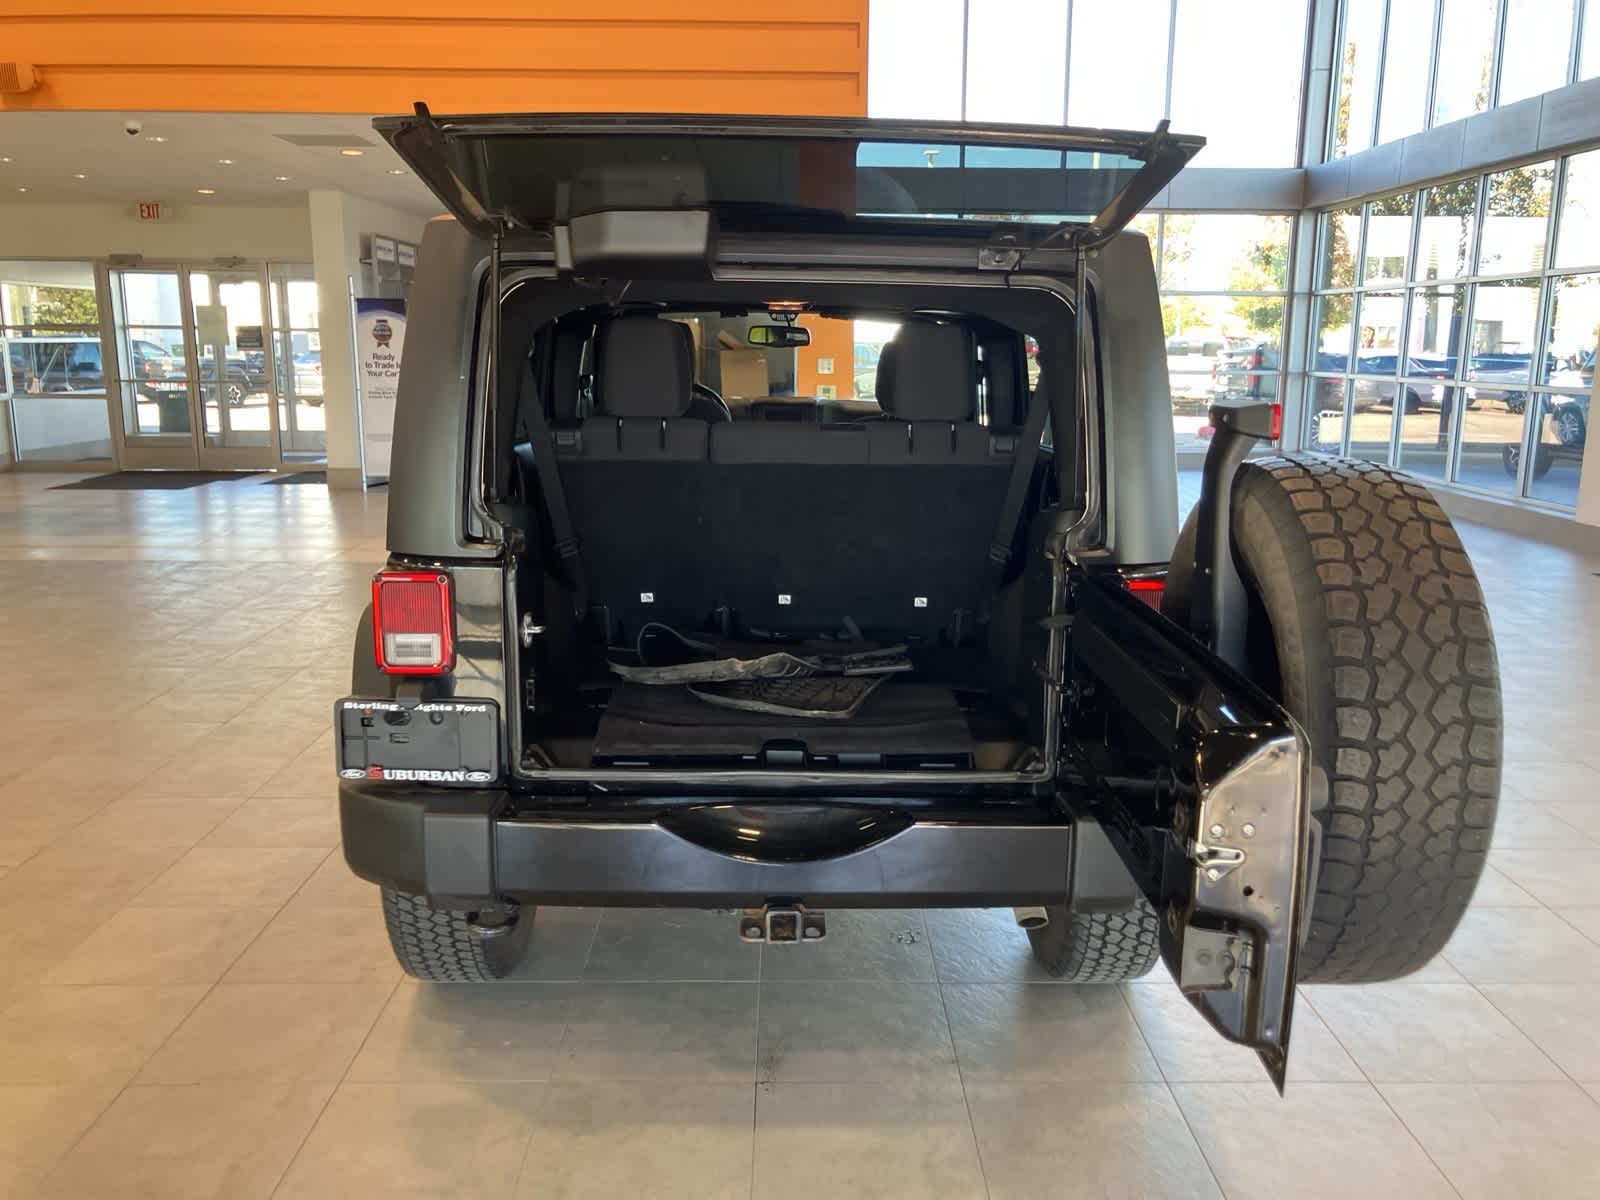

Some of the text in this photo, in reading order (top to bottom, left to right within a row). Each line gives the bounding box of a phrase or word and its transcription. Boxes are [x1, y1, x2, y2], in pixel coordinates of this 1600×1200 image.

[140, 203, 160, 219] EXIT
[372, 352, 395, 362] Ready
[365, 361, 373, 369] to
[374, 361, 395, 369] Trade
[343, 702, 399, 712] Sterling
[456, 704, 487, 712] Ford
[368, 766, 465, 782] SUBURBAN
